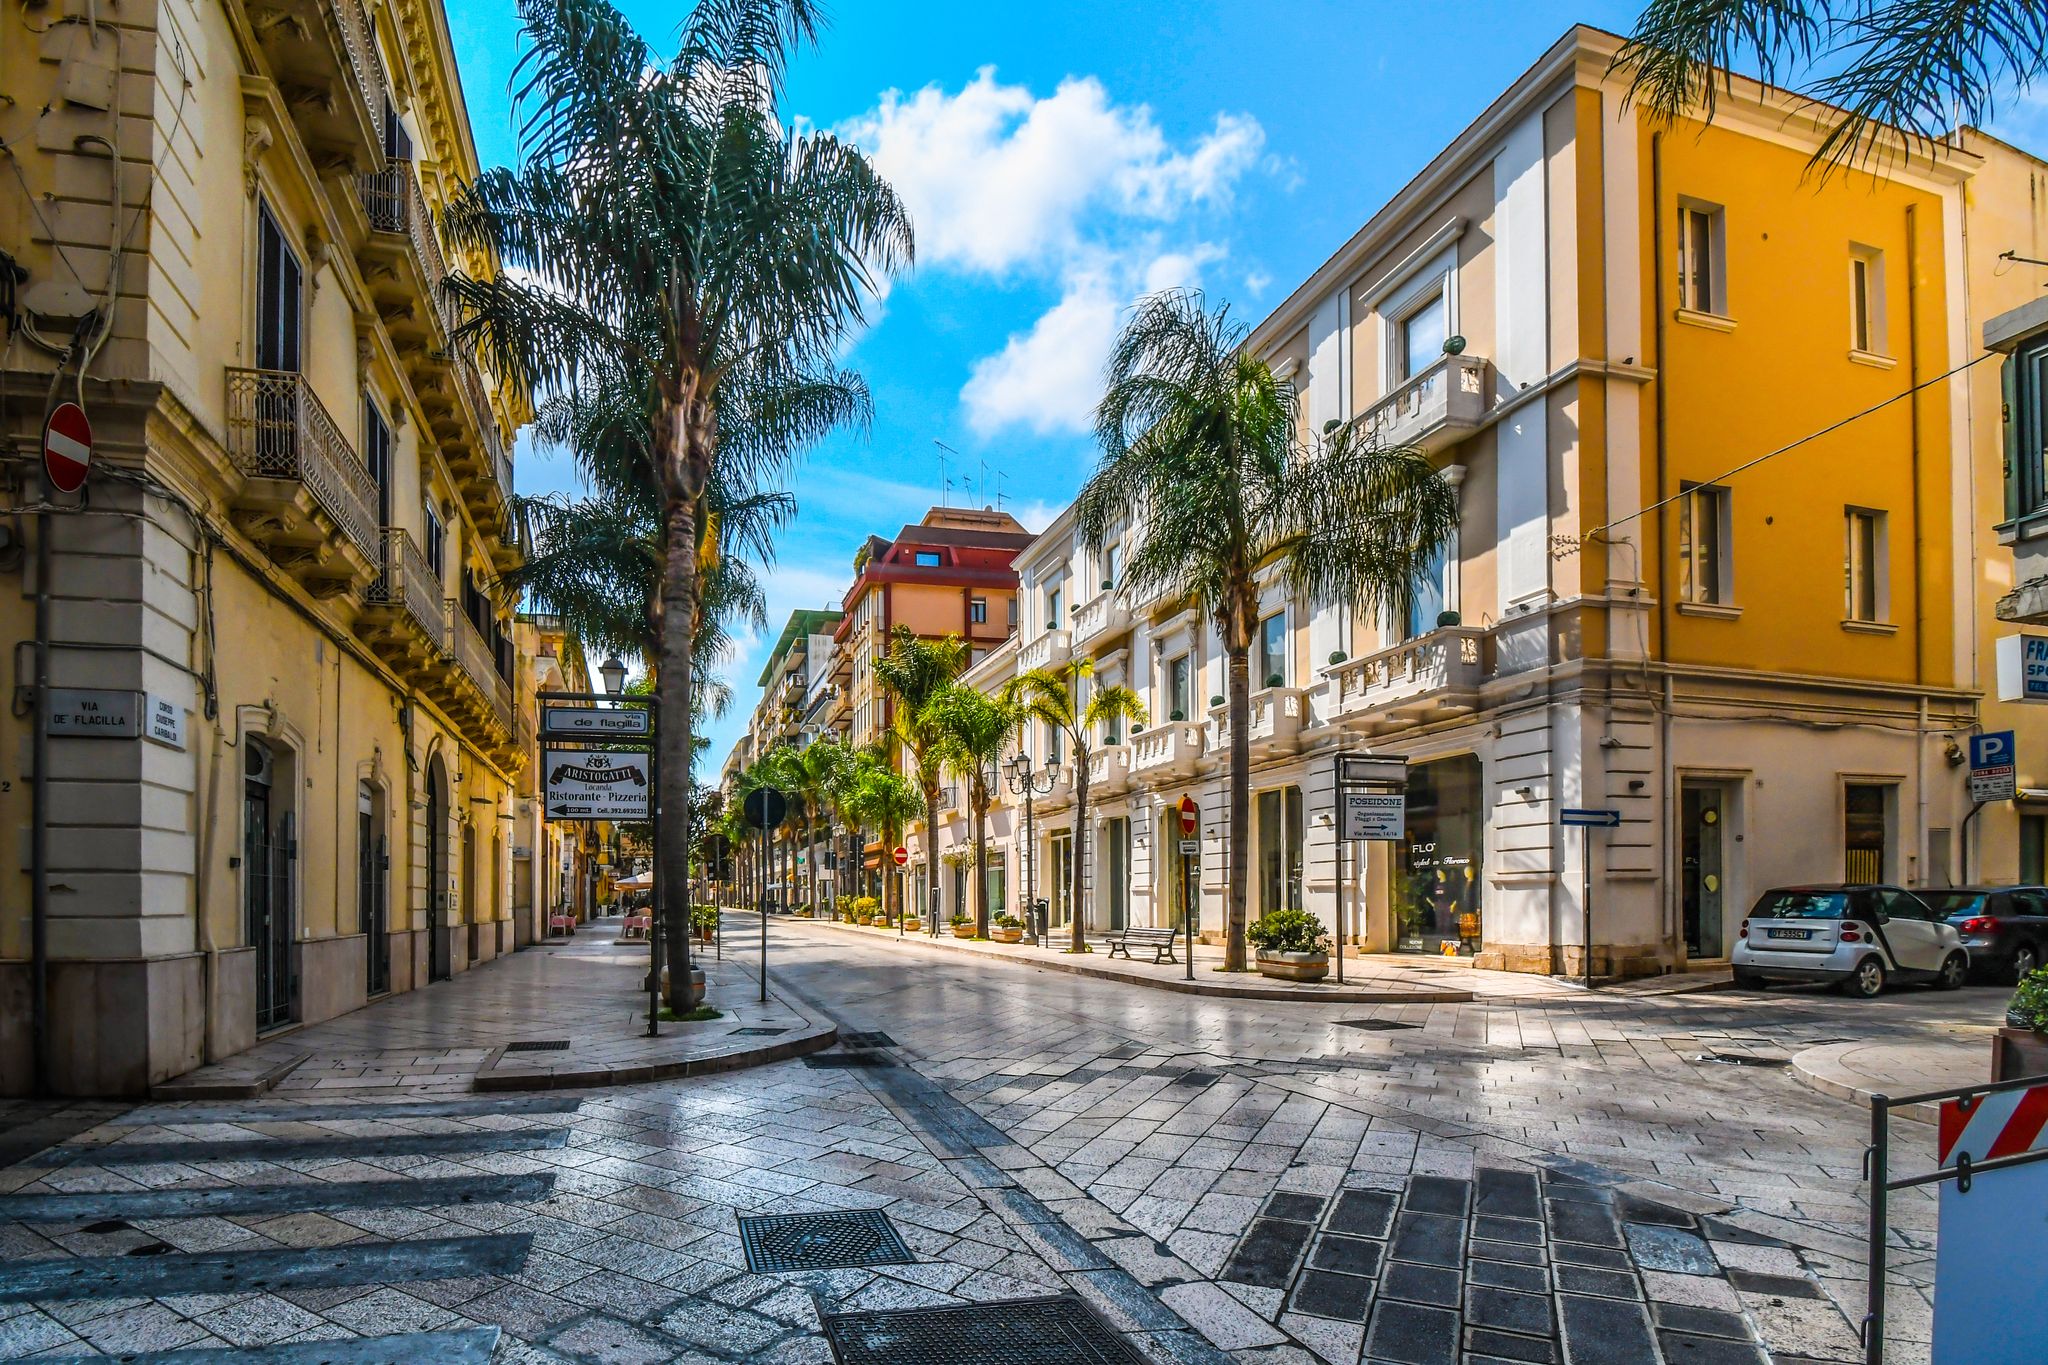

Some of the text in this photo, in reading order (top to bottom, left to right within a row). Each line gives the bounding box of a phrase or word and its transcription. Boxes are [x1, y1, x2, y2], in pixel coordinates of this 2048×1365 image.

[81, 701, 98, 711] VIA
[574, 718, 593, 727] de
[1979, 737, 2003, 764] P
[564, 768, 632, 781] ARISTOGATTI
[584, 783, 613, 791] Locanda
[549, 791, 601, 802] Ristorante
[608, 792, 647, 802] Pizzeria
[1349, 797, 1402, 806] POSEIDONE
